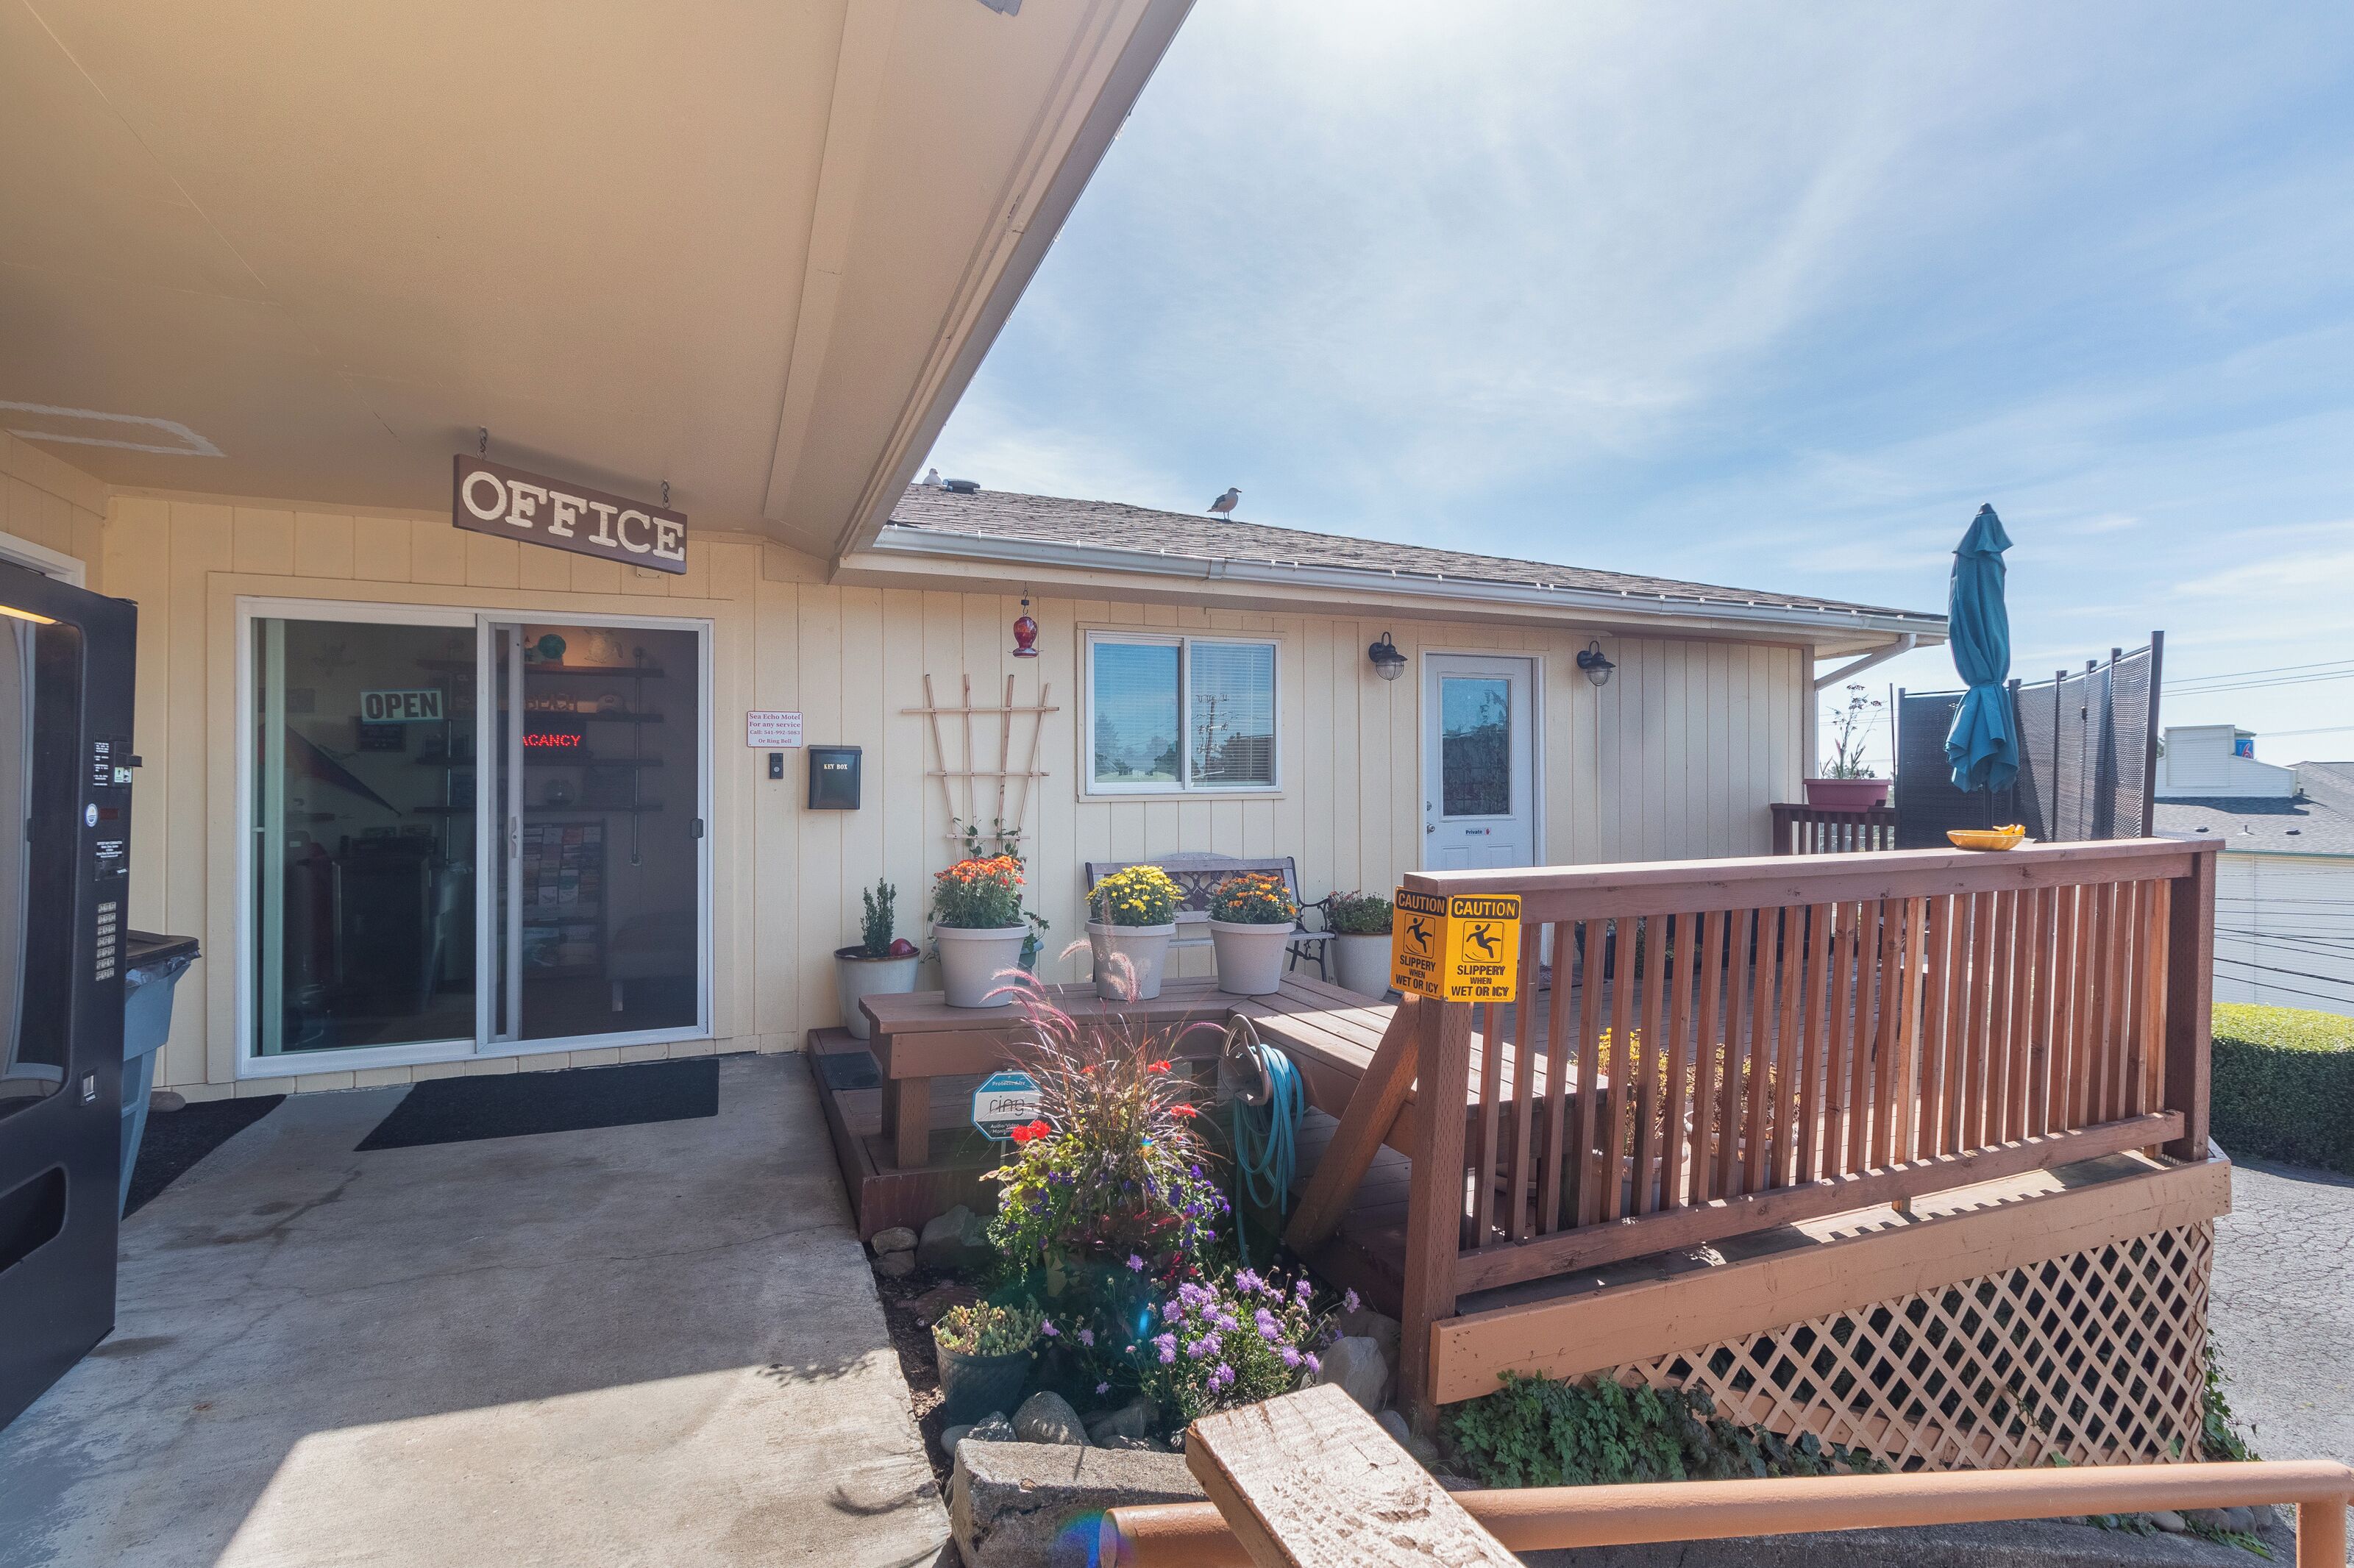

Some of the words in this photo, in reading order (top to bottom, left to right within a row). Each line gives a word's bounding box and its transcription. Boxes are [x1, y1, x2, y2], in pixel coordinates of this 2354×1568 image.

[462, 471, 685, 561] OFFICE
[366, 693, 438, 719] OPEN
[522, 734, 581, 746] CANCY
[2241, 743, 2253, 759] 6
[1398, 893, 1445, 913] CAUTION
[1454, 901, 1516, 916] CAUTION
[1400, 955, 1436, 972] SLIPPERY
[1457, 965, 1505, 976] SLIPPERY
[1409, 968, 1426, 979] WHEN
[1470, 977, 1492, 985] WHEN
[1395, 974, 1412, 986] WET
[1413, 978, 1423, 990] OR
[1426, 981, 1439, 994] ICY
[1451, 986, 1473, 997] WET
[1475, 986, 1490, 997] OR
[1492, 986, 1510, 997] ICY
[989, 1095, 1025, 1116] ring
